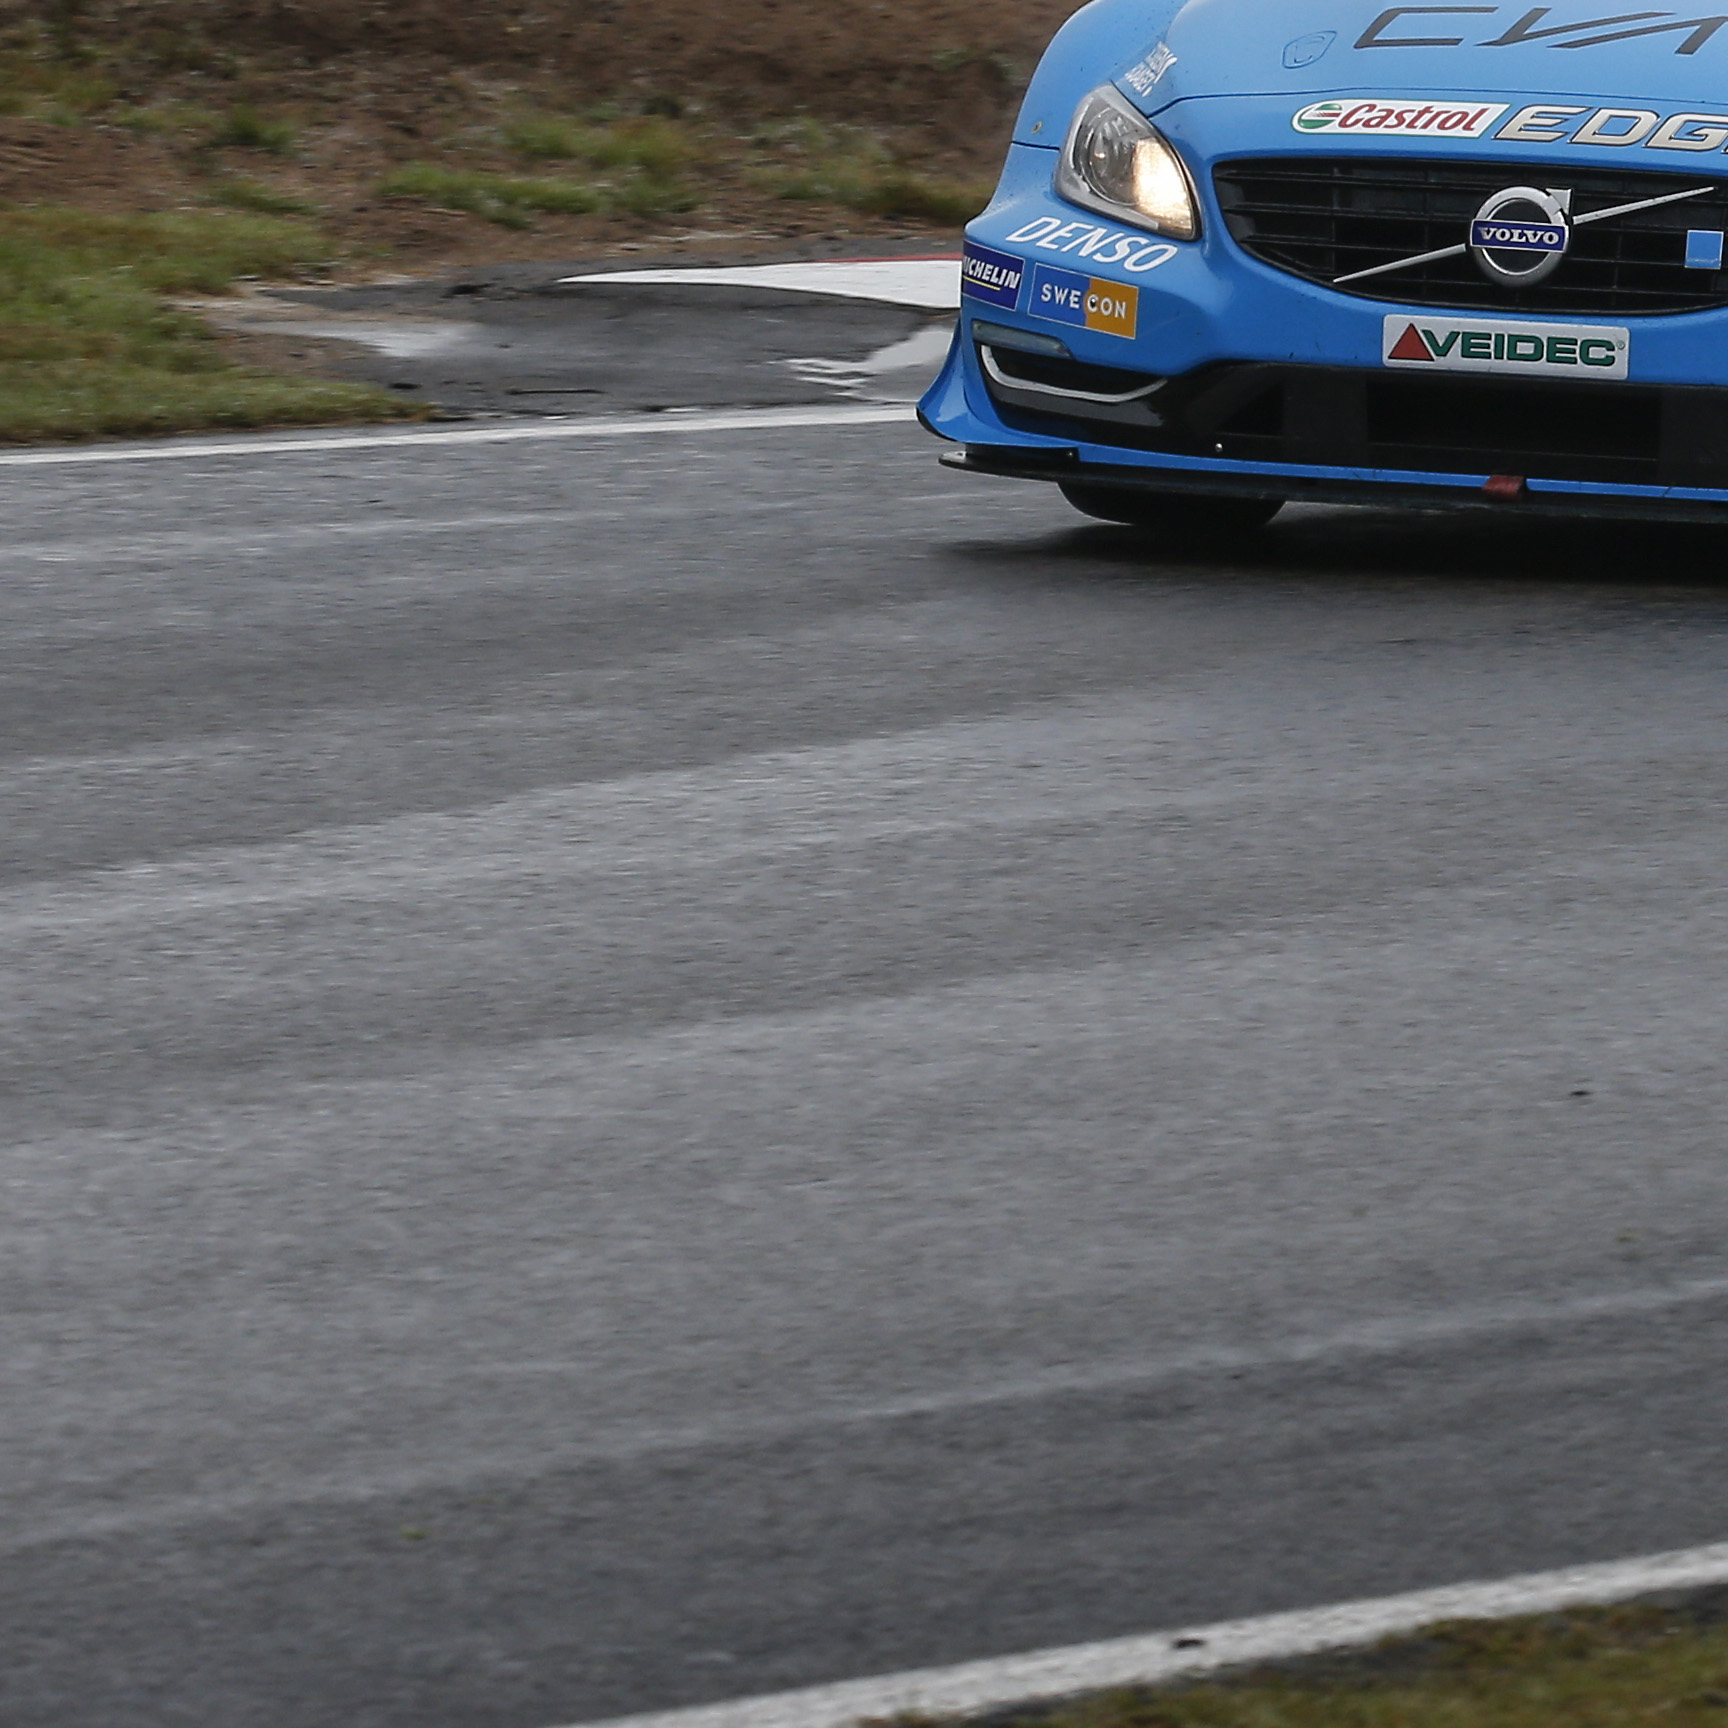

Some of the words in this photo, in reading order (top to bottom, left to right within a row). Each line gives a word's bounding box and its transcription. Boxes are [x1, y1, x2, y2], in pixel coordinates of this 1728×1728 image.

[1338, 102, 1490, 133] Castrol
[1005, 216, 1178, 272] DENSO
[1477, 225, 1561, 246] VOLVO
[1421, 328, 1617, 368] VEIDEC
